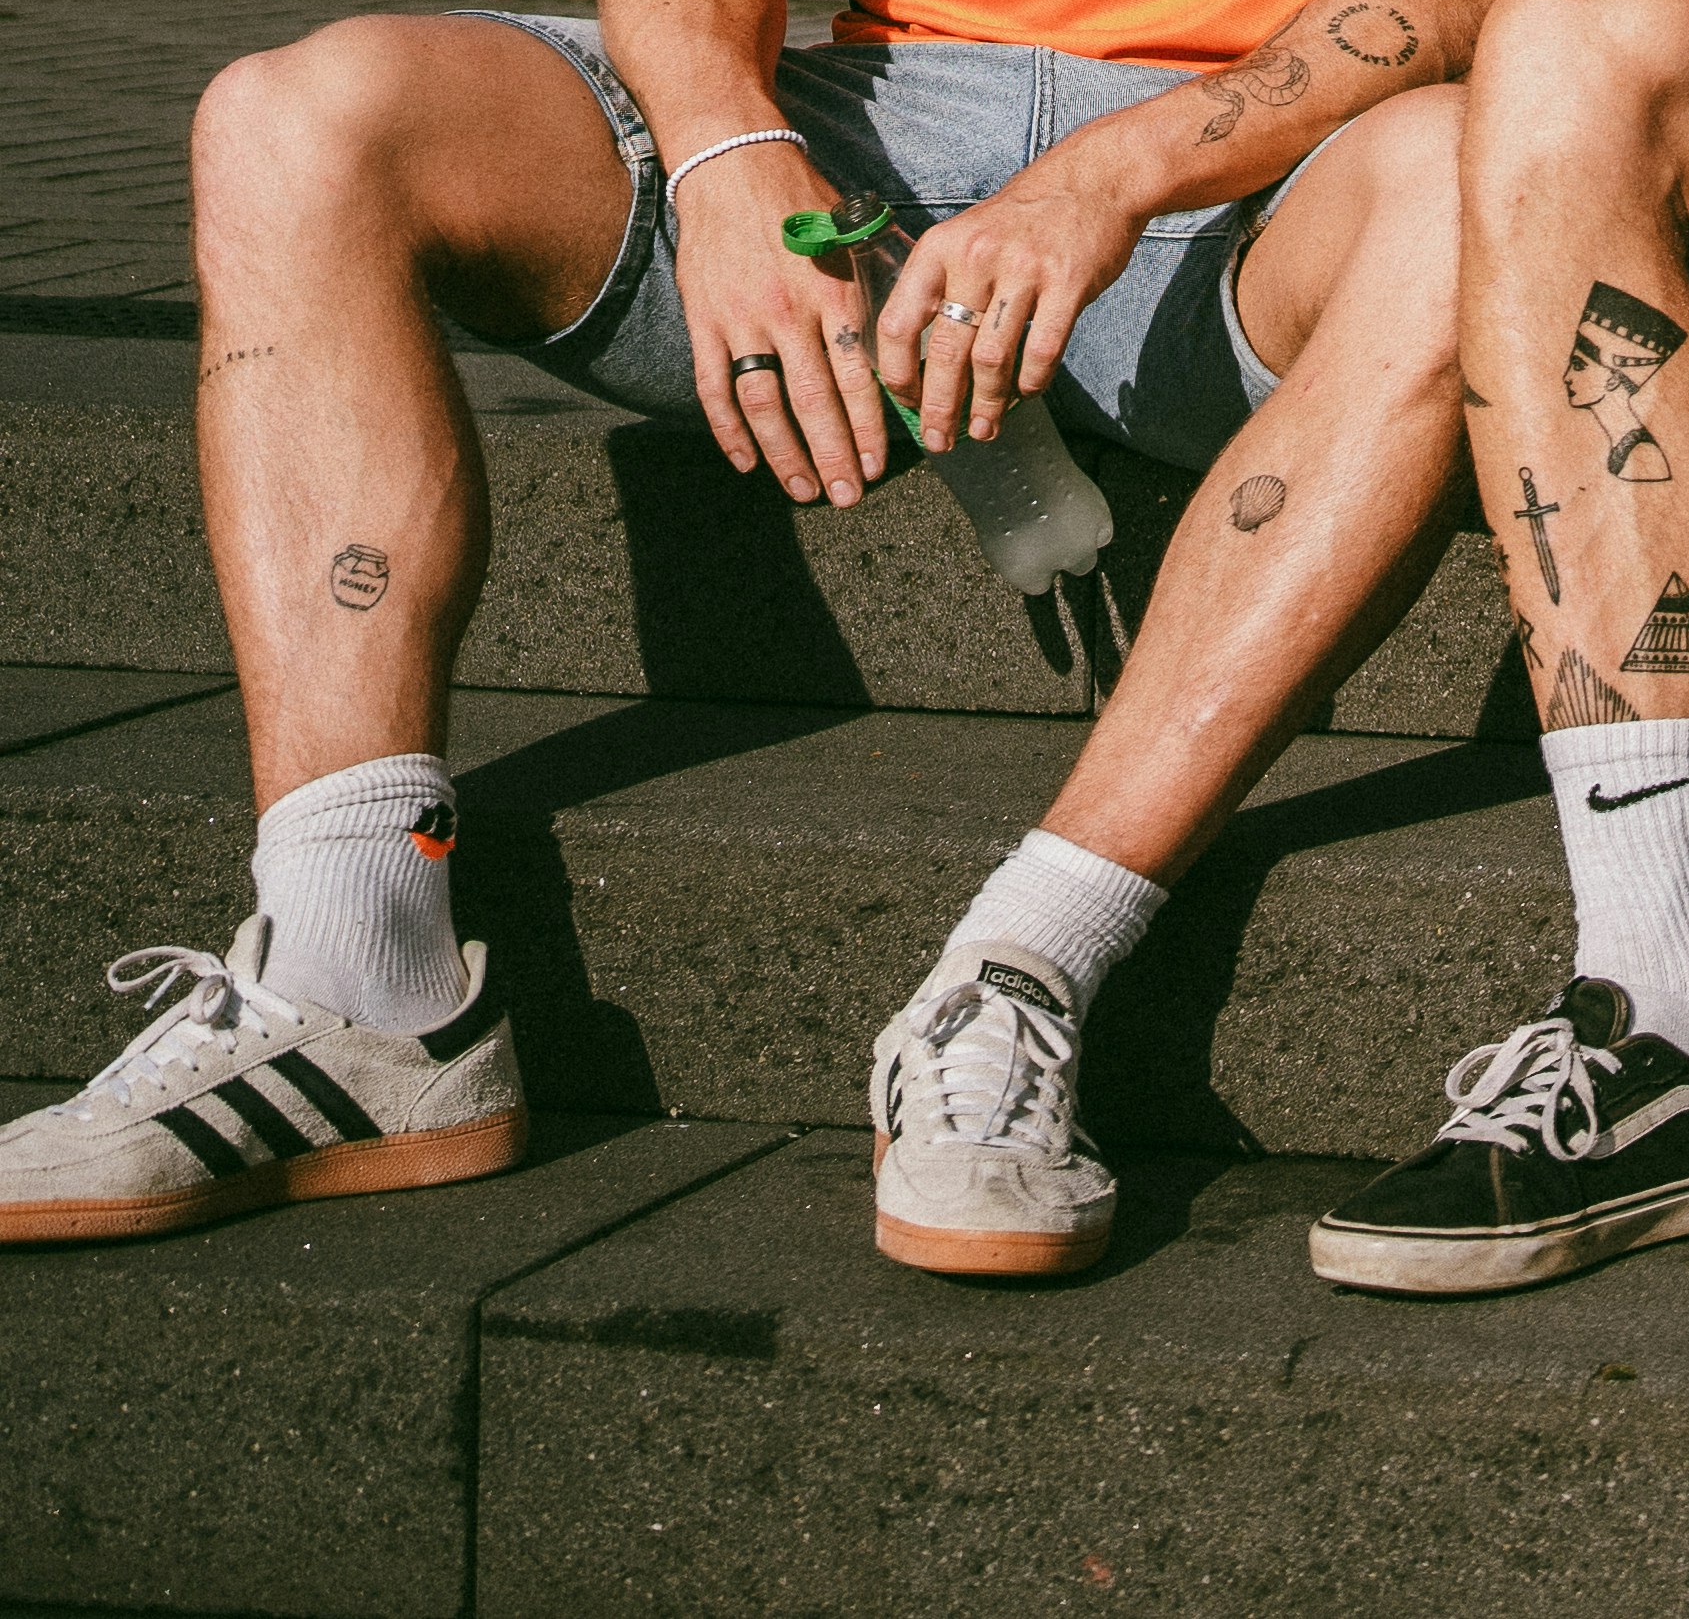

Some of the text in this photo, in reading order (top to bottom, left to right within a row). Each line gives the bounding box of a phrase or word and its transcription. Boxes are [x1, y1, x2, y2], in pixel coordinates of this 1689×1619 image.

[1388, 8, 1415, 32] THE
[339, 578, 378, 594] HONEY
[989, 971, 1051, 1007] adidas
